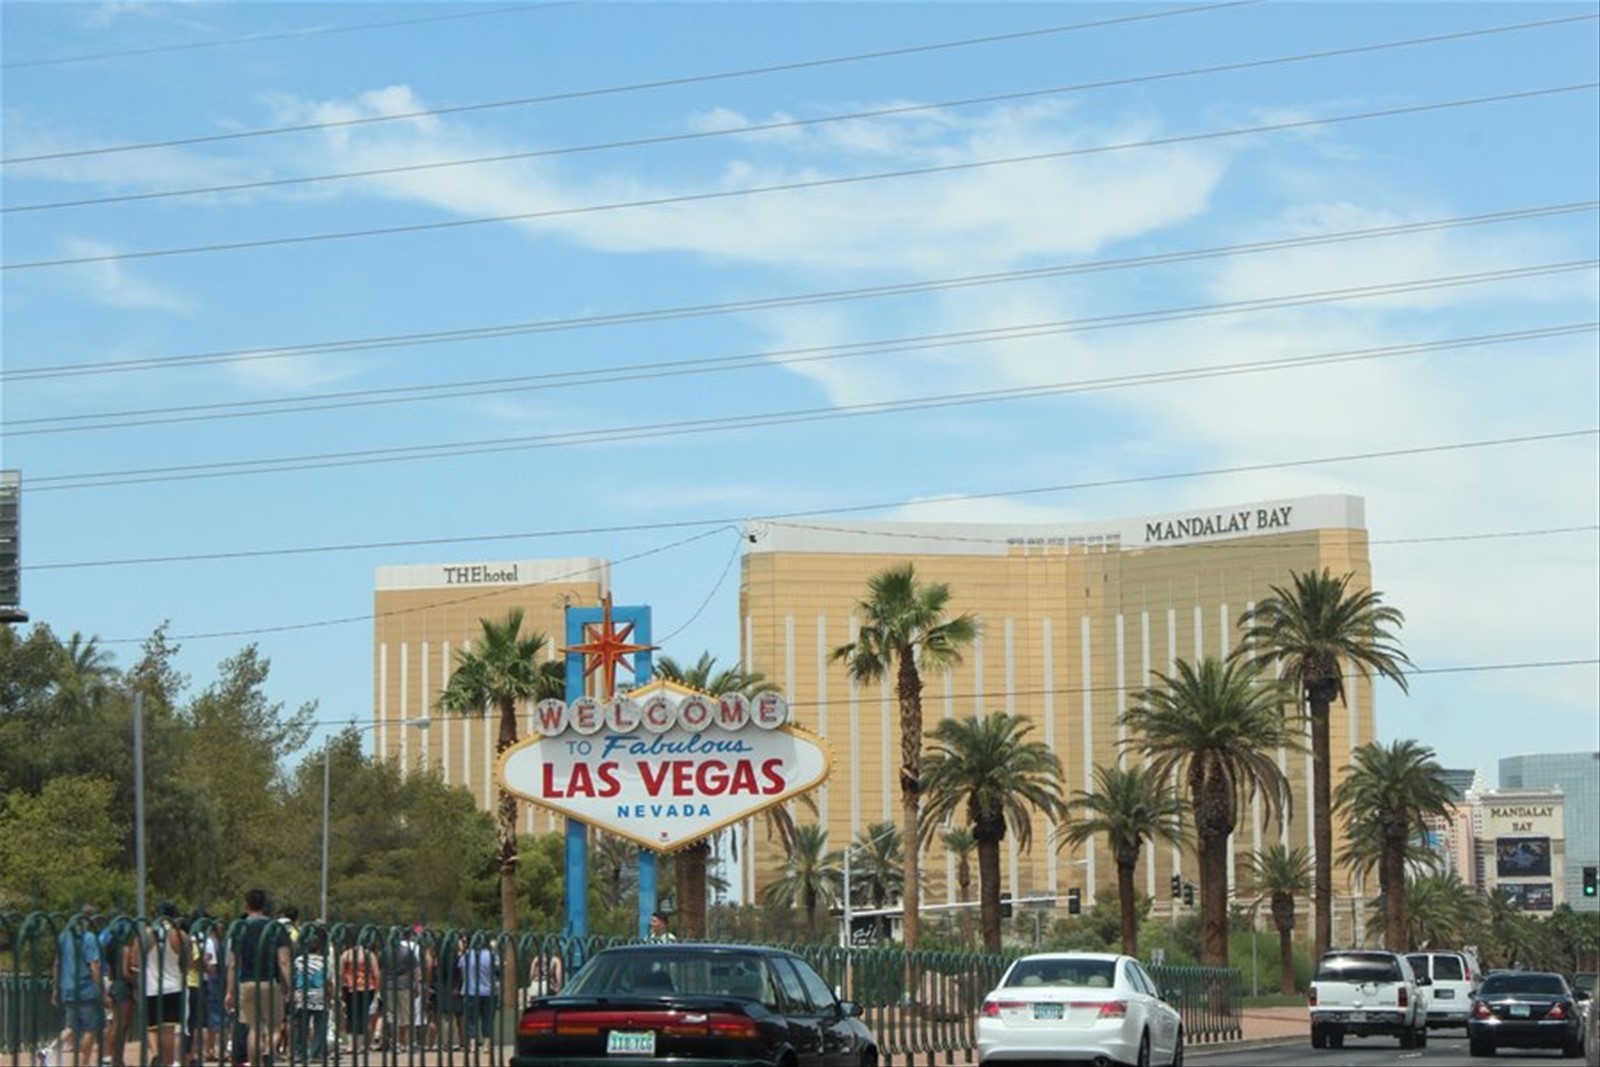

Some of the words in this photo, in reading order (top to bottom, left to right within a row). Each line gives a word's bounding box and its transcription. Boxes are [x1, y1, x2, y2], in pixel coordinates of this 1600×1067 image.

[1145, 511, 1251, 542] MANDALAY
[1256, 506, 1293, 529] BAY
[538, 699, 779, 729] WELCOME
[568, 740, 592, 756] TO
[601, 735, 754, 760] Fabulous
[541, 761, 621, 799] LAS
[636, 758, 786, 797] VEGAS
[617, 803, 712, 818] NEVADA
[1490, 807, 1555, 818] MANDALAY
[1512, 822, 1534, 832] BAY
